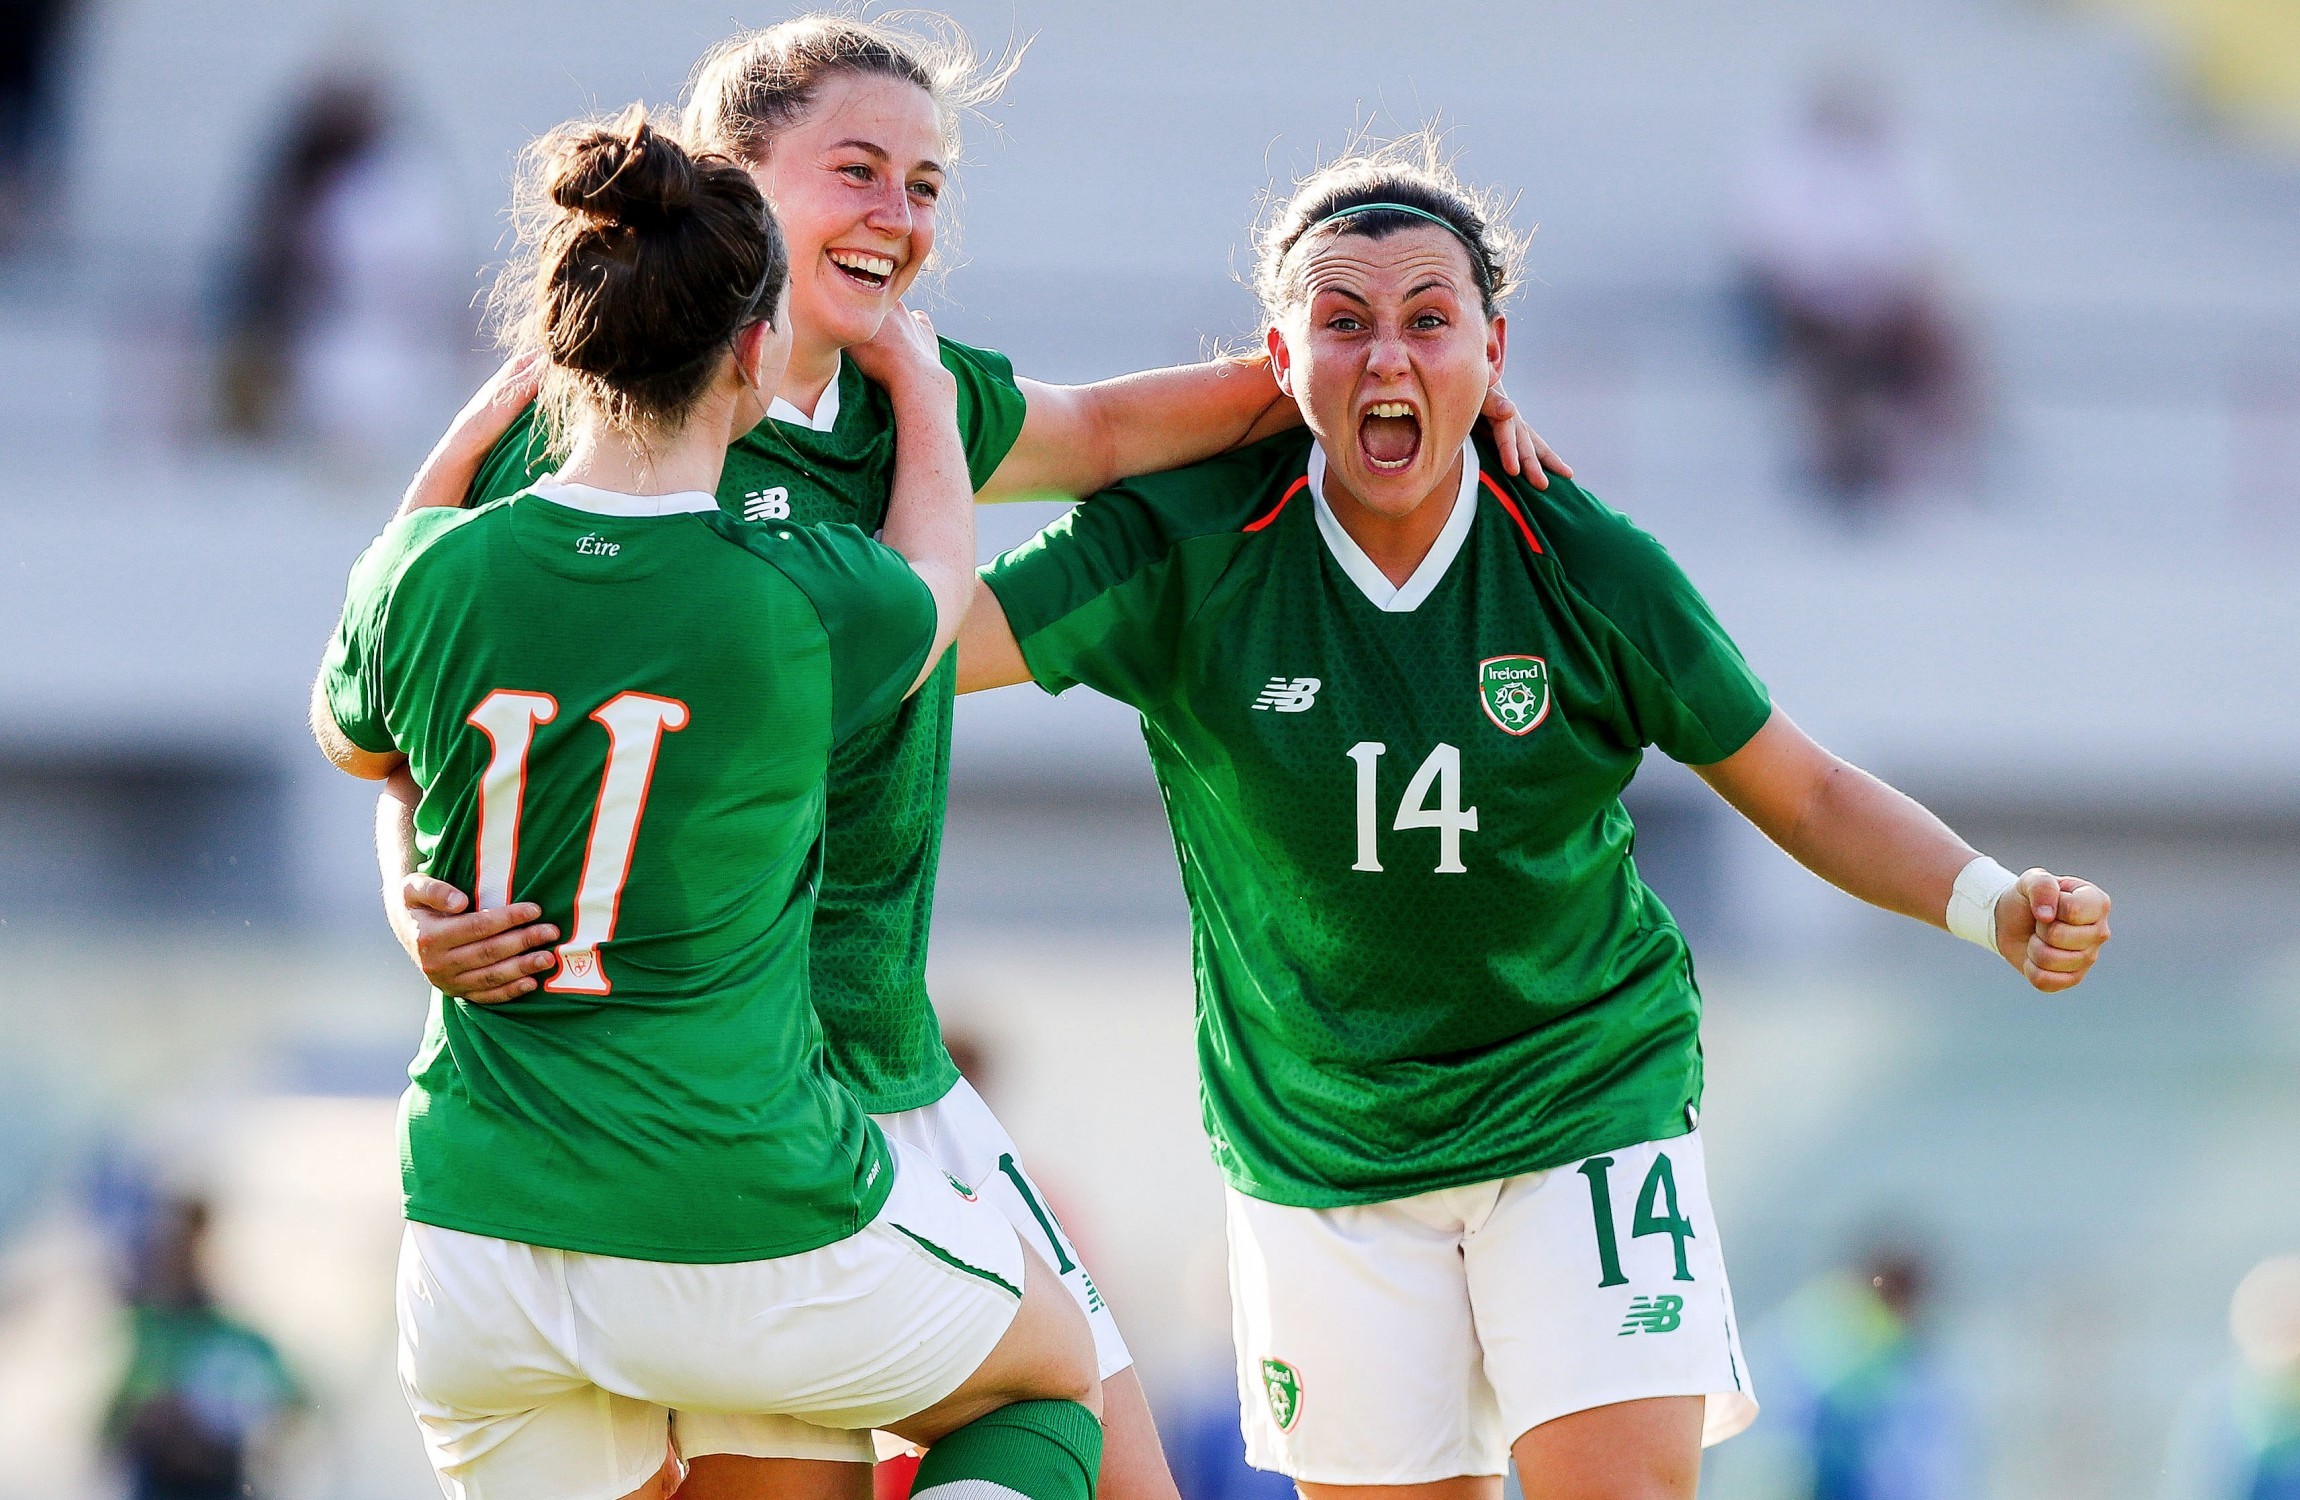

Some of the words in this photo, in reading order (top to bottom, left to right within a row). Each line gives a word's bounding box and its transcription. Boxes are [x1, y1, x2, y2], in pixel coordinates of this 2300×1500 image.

[575, 532, 621, 557] Éire
[1488, 665, 1538, 680] Ireland
[466, 688, 691, 996] 11
[1346, 741, 1478, 873] 14
[1576, 1152, 1696, 1288] 14
